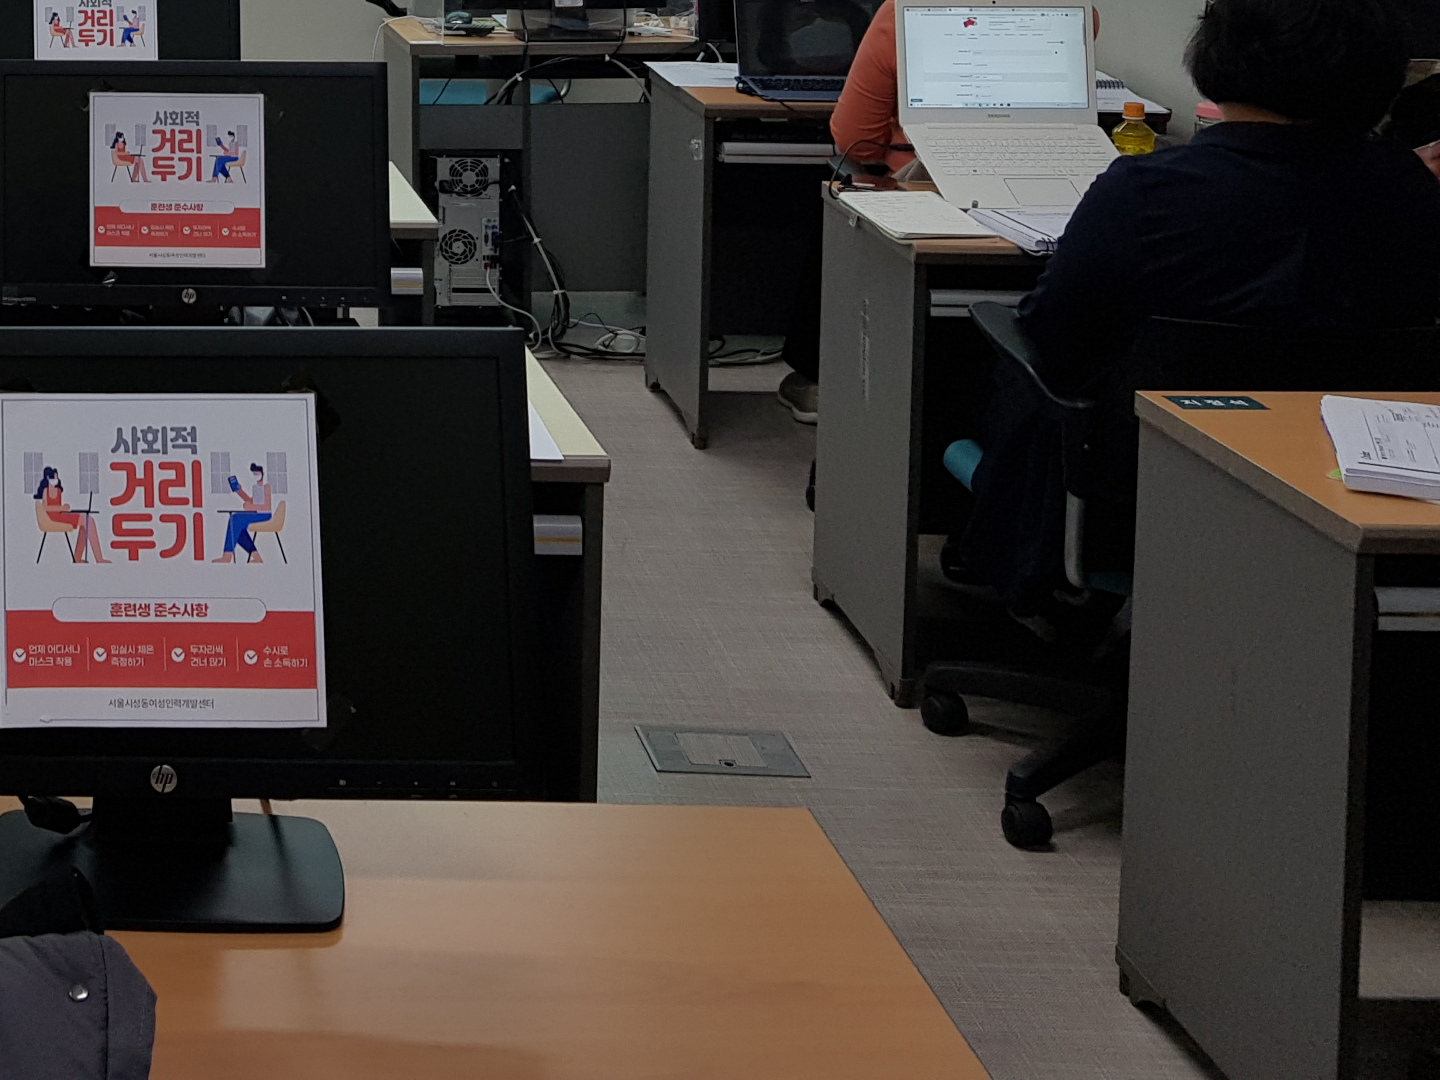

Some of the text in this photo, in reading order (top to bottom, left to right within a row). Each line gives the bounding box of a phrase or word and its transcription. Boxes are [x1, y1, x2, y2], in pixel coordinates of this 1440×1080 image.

[78, 9, 114, 27] 거리
[78, 28, 115, 47] 두기
[153, 110, 200, 126] 사회적
[151, 128, 202, 154] 거리
[151, 156, 203, 182] 두기
[111, 425, 198, 455] 사회적
[108, 459, 203, 509] 거리
[110, 512, 205, 561] 두기
[110, 603, 209, 618] 훈련생 준수사항
[29, 644, 80, 655] 언제 어디서나
[111, 644, 136, 655] 입실시
[190, 644, 223, 655] 두자리씩
[263, 645, 289, 656] 수시로
[29, 657, 54, 667] 마스크
[111, 657, 144, 667] 측정하기
[190, 657, 207, 667] 건너
[263, 657, 308, 668] 손 소독하기
[152, 765, 176, 792] hp
